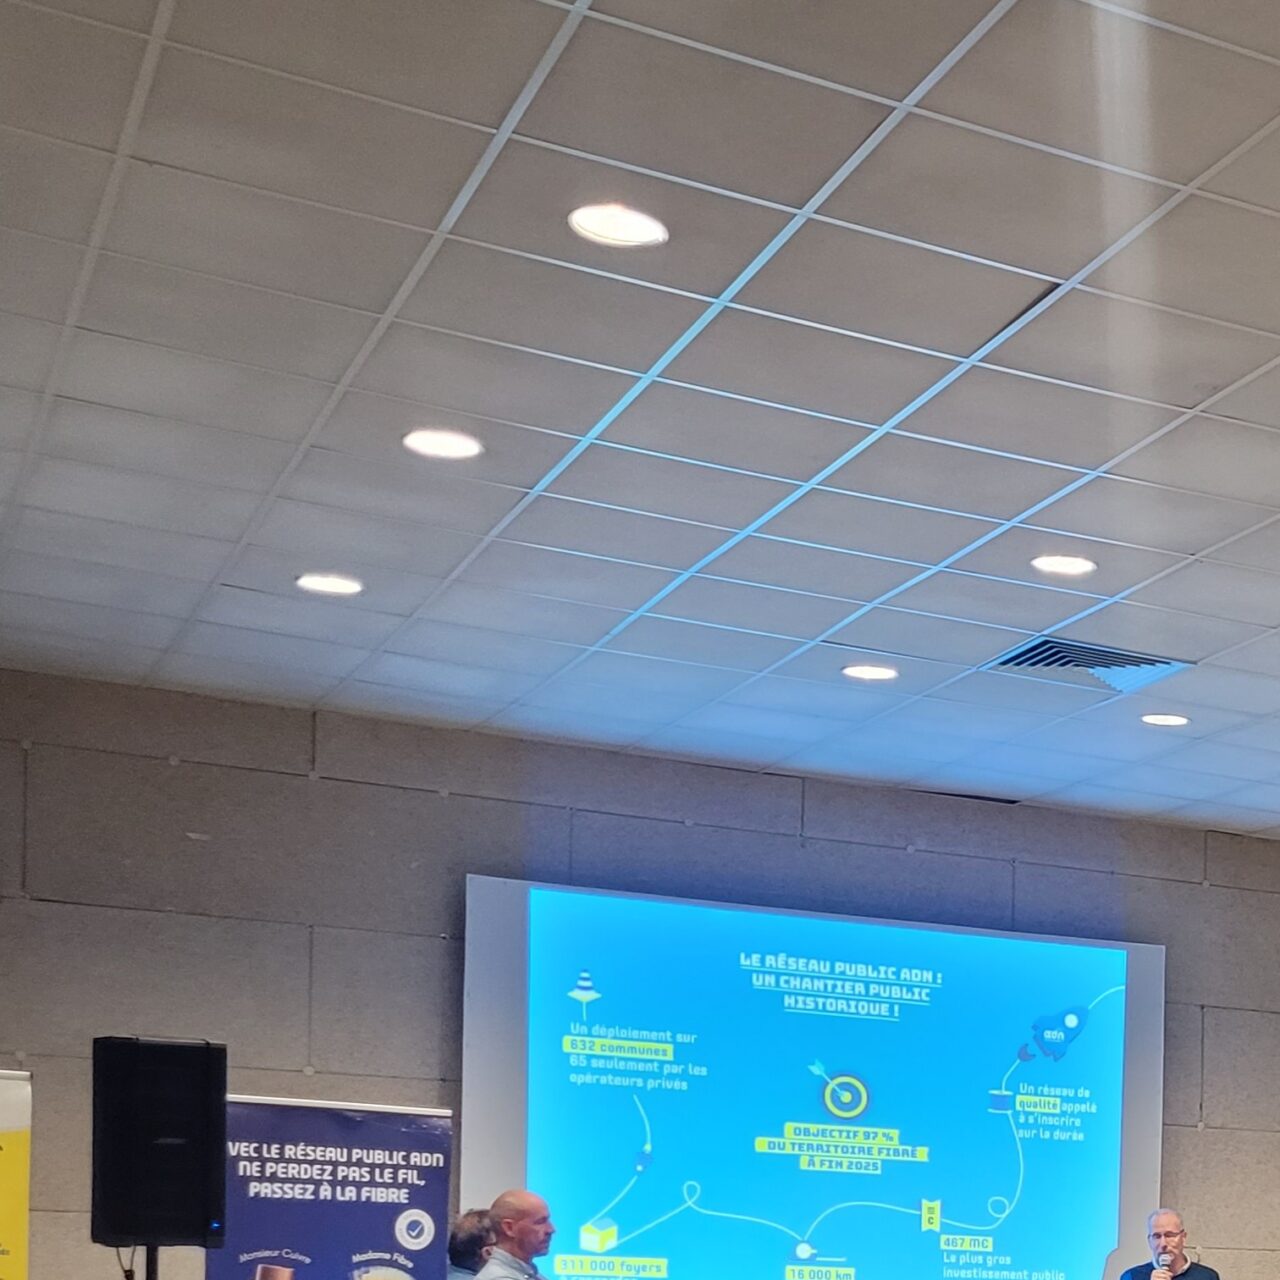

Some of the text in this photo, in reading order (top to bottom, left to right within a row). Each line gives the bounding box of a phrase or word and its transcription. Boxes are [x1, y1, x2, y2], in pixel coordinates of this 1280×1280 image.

[740, 952, 761, 967] LE
[765, 953, 830, 973] RÉSEAU
[835, 962, 896, 979] PUBLIC
[900, 967, 932, 983] ADN
[752, 973, 930, 1001] UN CHANTIER PUBLIC
[784, 994, 889, 1016] HISTORIQUE
[570, 1023, 697, 1043] Un déploiement sur
[570, 1039, 668, 1057] 632 communes
[570, 1055, 707, 1076] 65 seulement par les
[569, 1072, 688, 1091] opérateurs privés
[1019, 1083, 1090, 1098] Un réseau de
[1018, 1098, 1097, 1114] qualité appelé
[793, 1126, 893, 1142] OBJECTIF 97 %
[1018, 1128, 1084, 1141] sur la durée
[228, 1141, 444, 1167] VEC LE RÉSEAU PUBLIC ADN
[767, 1141, 786, 1151] DU
[790, 1142, 873, 1156] TERRITOIRE
[819, 1158, 843, 1169] FIN
[846, 1160, 879, 1171] 2025
[238, 1161, 426, 1186] NE PERDEZ PAS LE FIL,
[249, 1182, 409, 1203] PASSEZ À LA FIBRE
[943, 1237, 965, 1248] 467
[239, 1250, 280, 1263] Monsieur
[352, 1251, 414, 1269] Madame Fibre
[943, 1252, 1011, 1267] Le plus gros
[561, 1260, 662, 1275] 311 000 foyers
[791, 1269, 852, 1280] 16 000 km
[943, 1267, 1028, 1280] investissement
